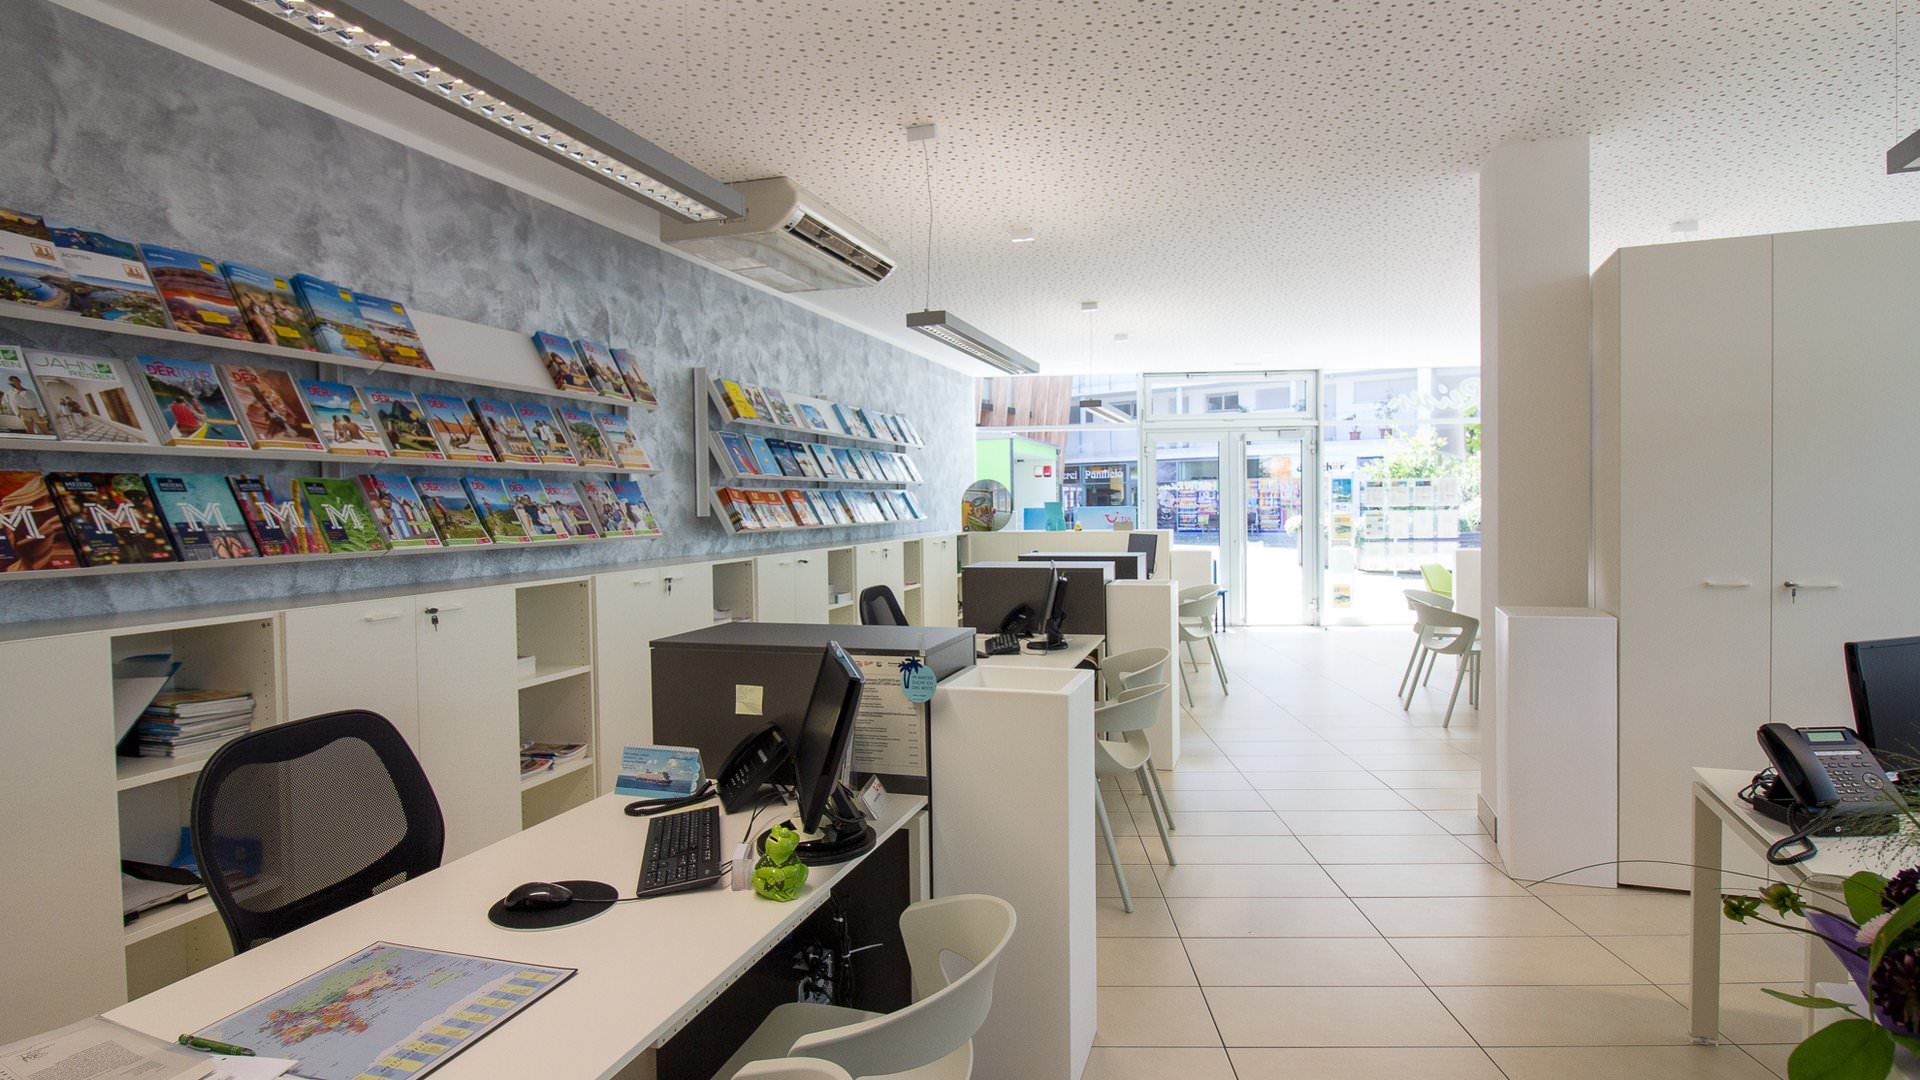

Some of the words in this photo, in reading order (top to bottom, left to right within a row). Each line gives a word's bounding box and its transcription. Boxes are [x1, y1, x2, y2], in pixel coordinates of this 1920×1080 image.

[34, 356, 97, 374] JAHN
[83, 502, 147, 535] M
[176, 502, 233, 532] M
[256, 501, 306, 530] M
[320, 503, 364, 530] M
